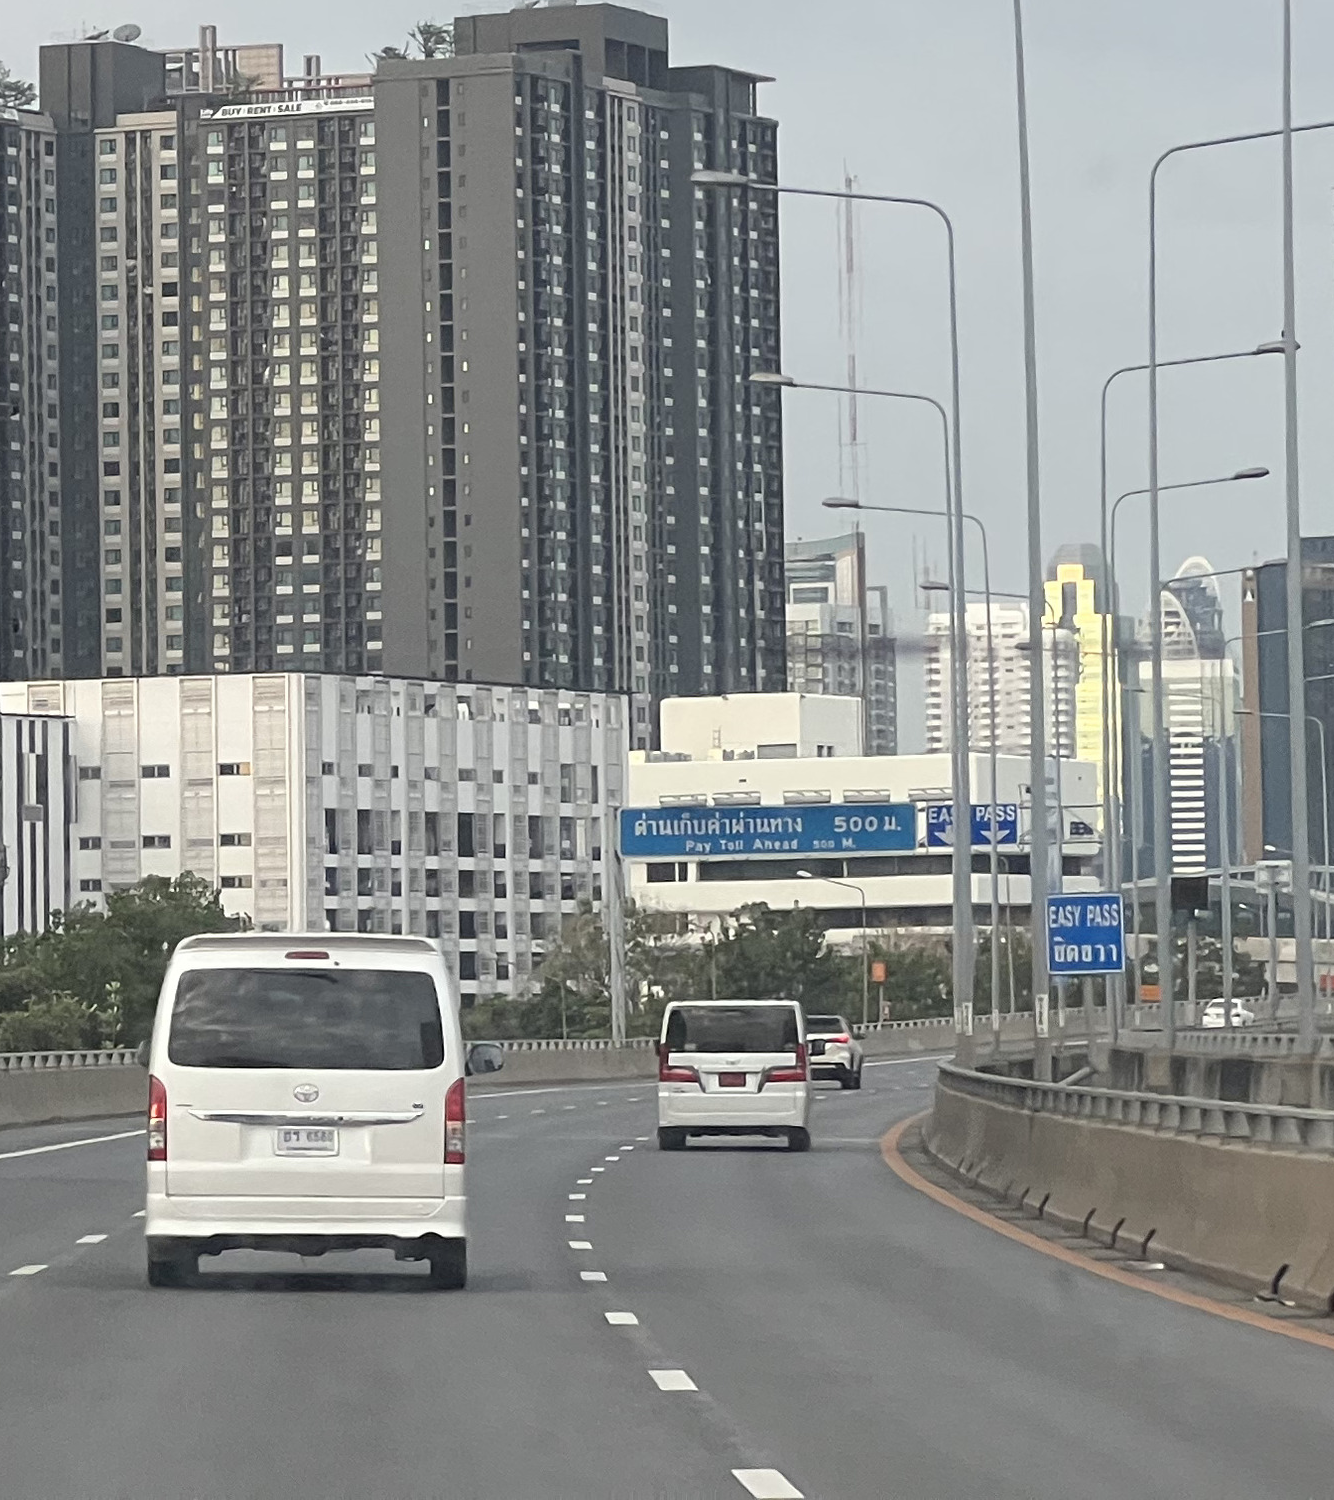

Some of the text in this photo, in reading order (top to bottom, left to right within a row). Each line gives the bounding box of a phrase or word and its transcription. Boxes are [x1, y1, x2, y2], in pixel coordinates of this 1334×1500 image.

[221, 107, 242, 117] BUY
[247, 105, 272, 115] RENT
[277, 103, 303, 113] SALE
[633, 811, 902, 836] ด่านเก็บค่าผ่านทาง 500 ม.
[928, 805, 1016, 824] EA PASS
[685, 839, 711, 854] Pay
[720, 839, 744, 851] Toll
[752, 838, 799, 851] Ahead
[1049, 903, 1119, 928] EASY PASS
[1053, 936, 1118, 963] ชิดขวา
